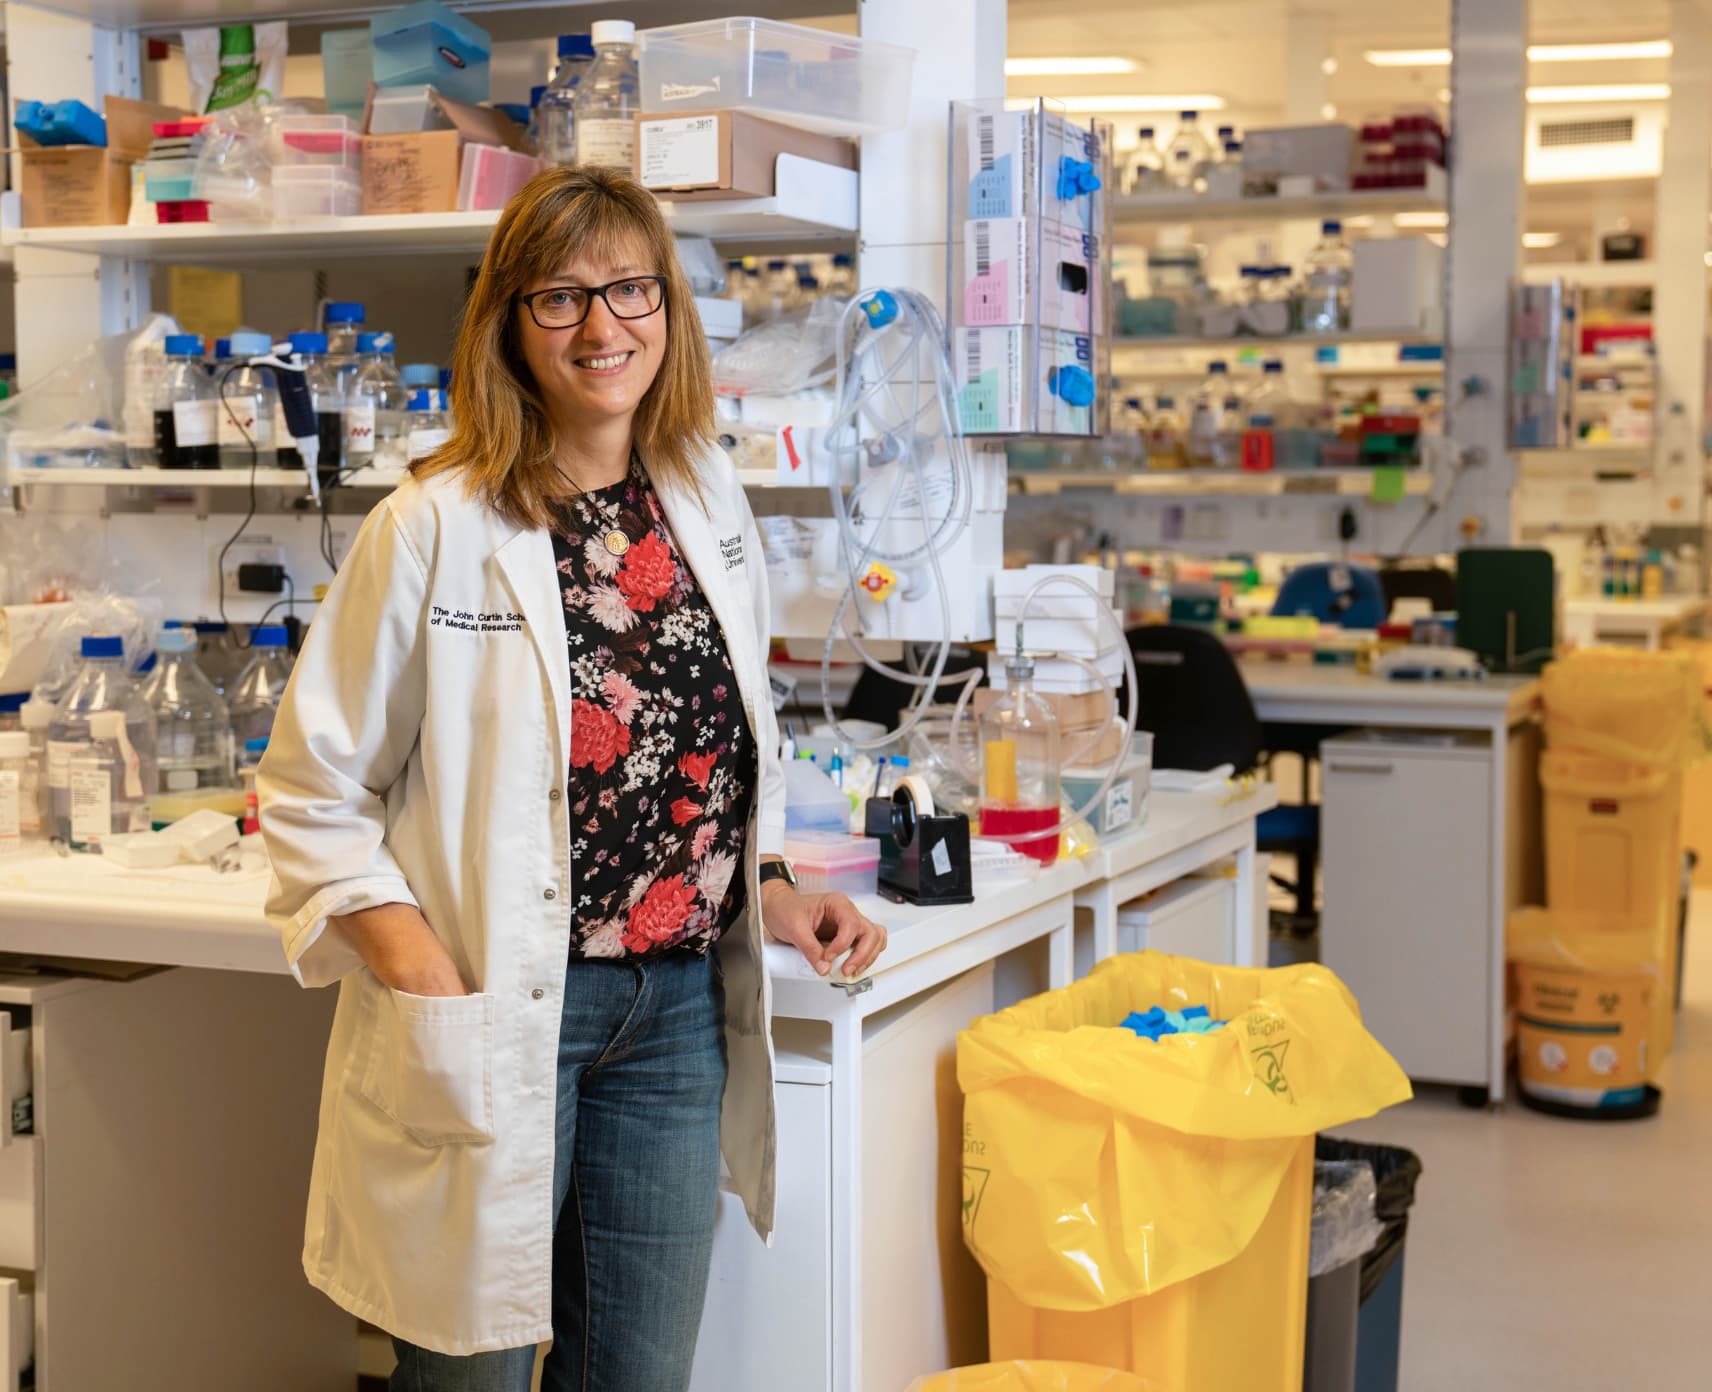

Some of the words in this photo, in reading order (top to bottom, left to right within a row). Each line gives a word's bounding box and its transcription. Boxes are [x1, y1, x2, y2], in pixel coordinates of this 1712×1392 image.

[433, 606, 449, 616] The
[453, 610, 474, 621] John
[477, 613, 503, 621] Curtin
[431, 618, 441, 626] of
[445, 619, 478, 632] Medical
[481, 623, 522, 632] Research
